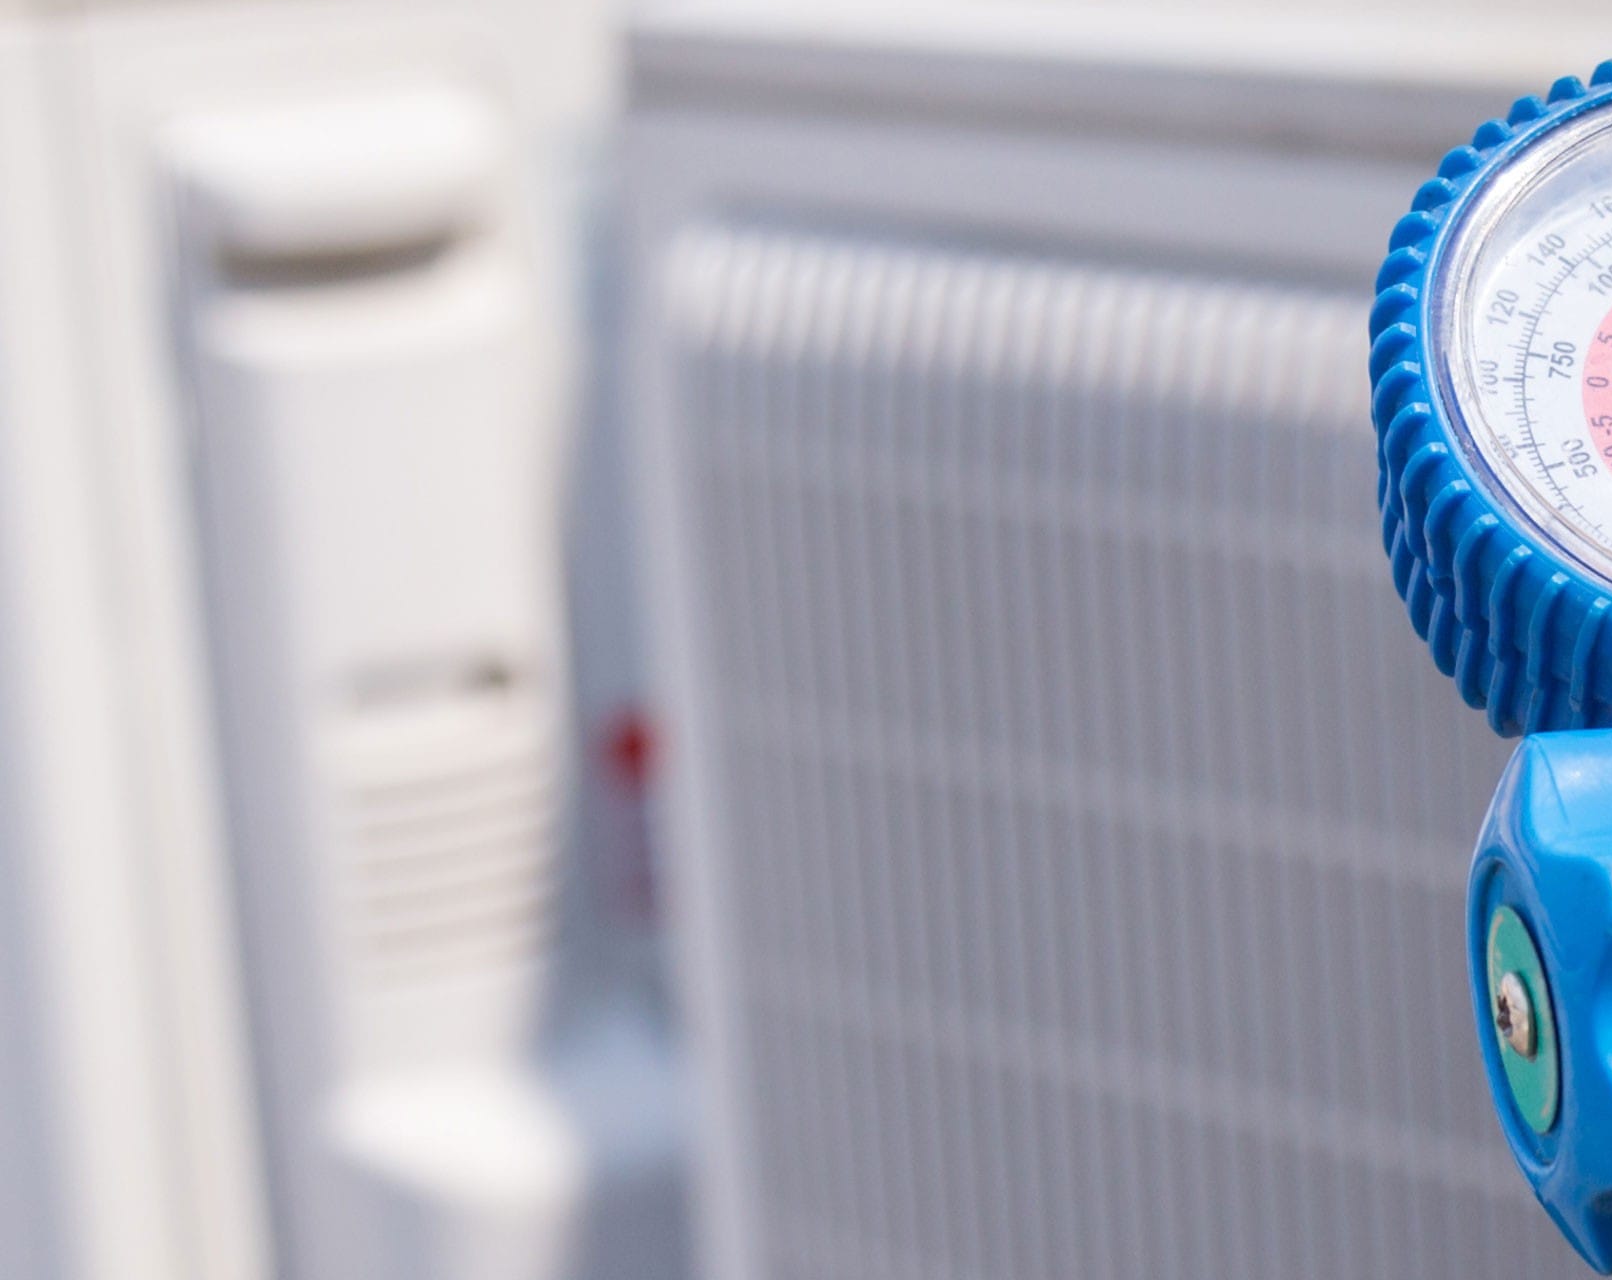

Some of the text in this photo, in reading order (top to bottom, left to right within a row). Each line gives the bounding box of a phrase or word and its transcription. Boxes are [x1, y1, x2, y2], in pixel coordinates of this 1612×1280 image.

[1527, 233, 1566, 267] 140
[1486, 288, 1519, 326] 120
[1548, 340, 1577, 380] 750
[1586, 375, 1609, 389] 0
[1561, 438, 1598, 479] 500
